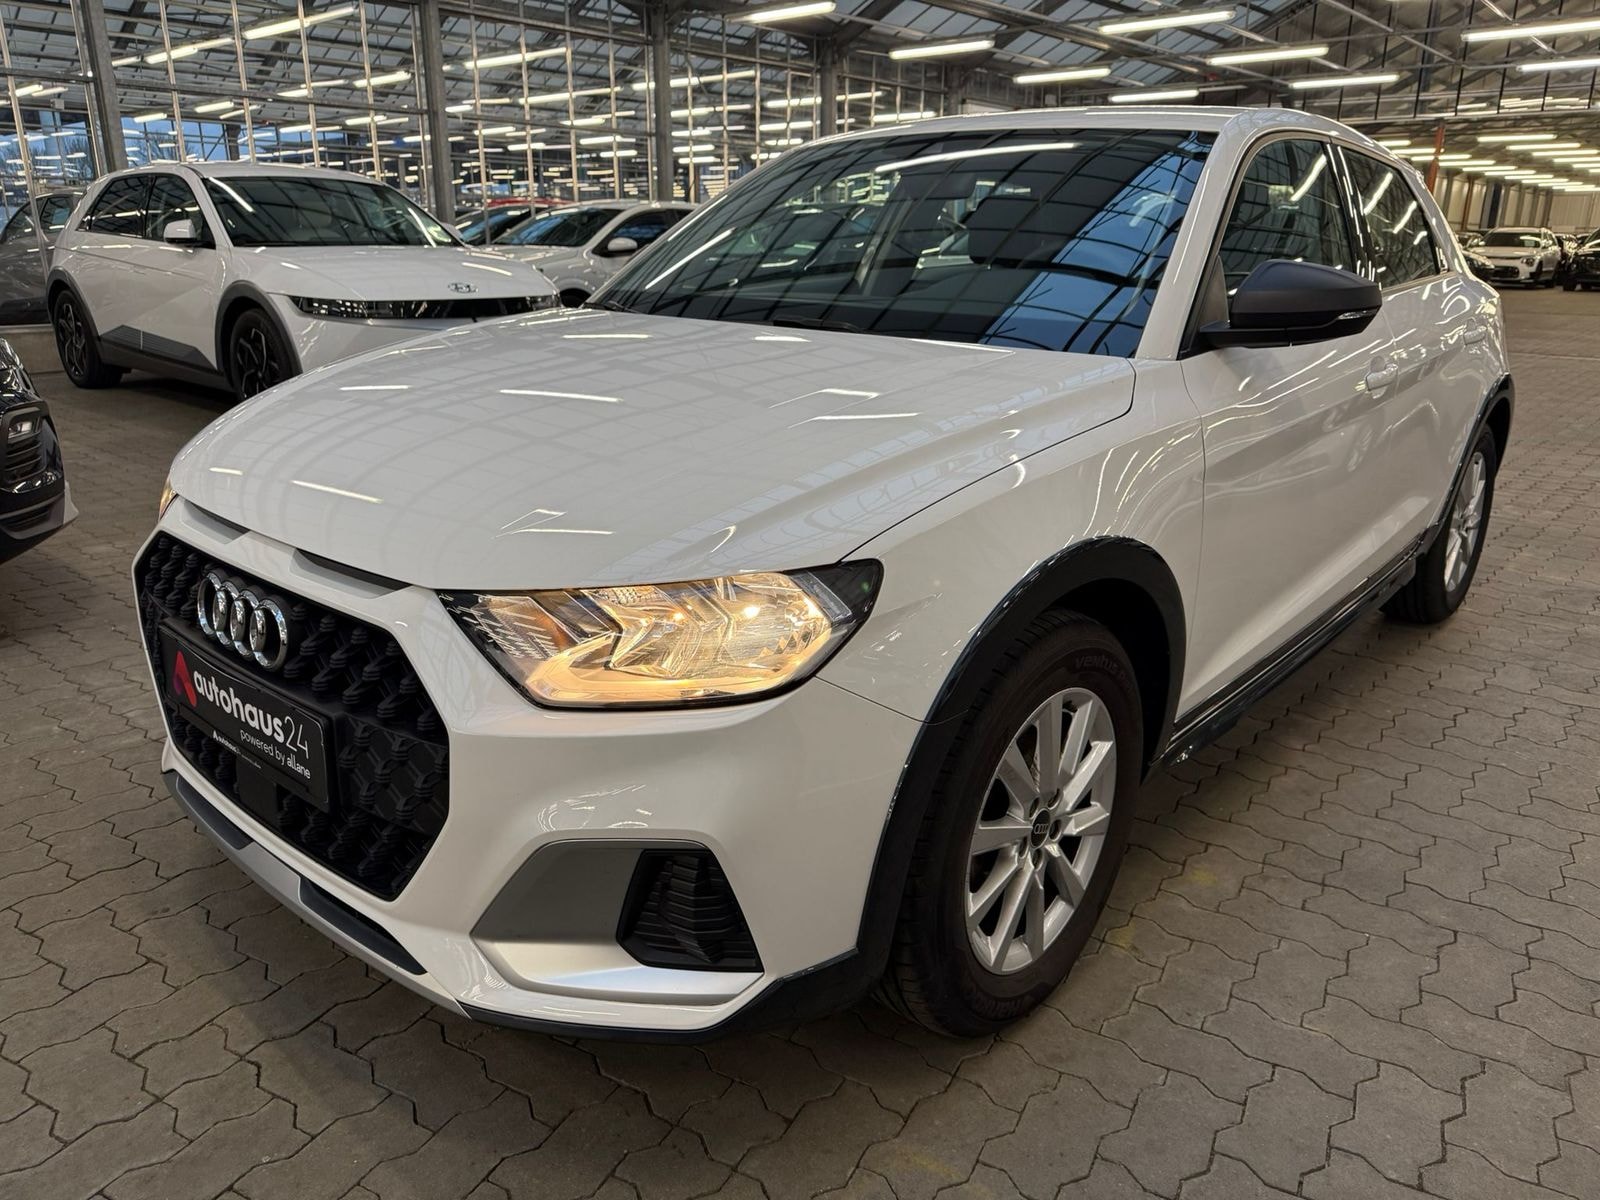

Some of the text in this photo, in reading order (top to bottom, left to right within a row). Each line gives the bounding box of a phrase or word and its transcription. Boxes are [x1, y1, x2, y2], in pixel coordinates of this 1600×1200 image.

[240, 729, 274, 757] powered
[275, 746, 285, 765] by
[287, 754, 311, 779] allane
